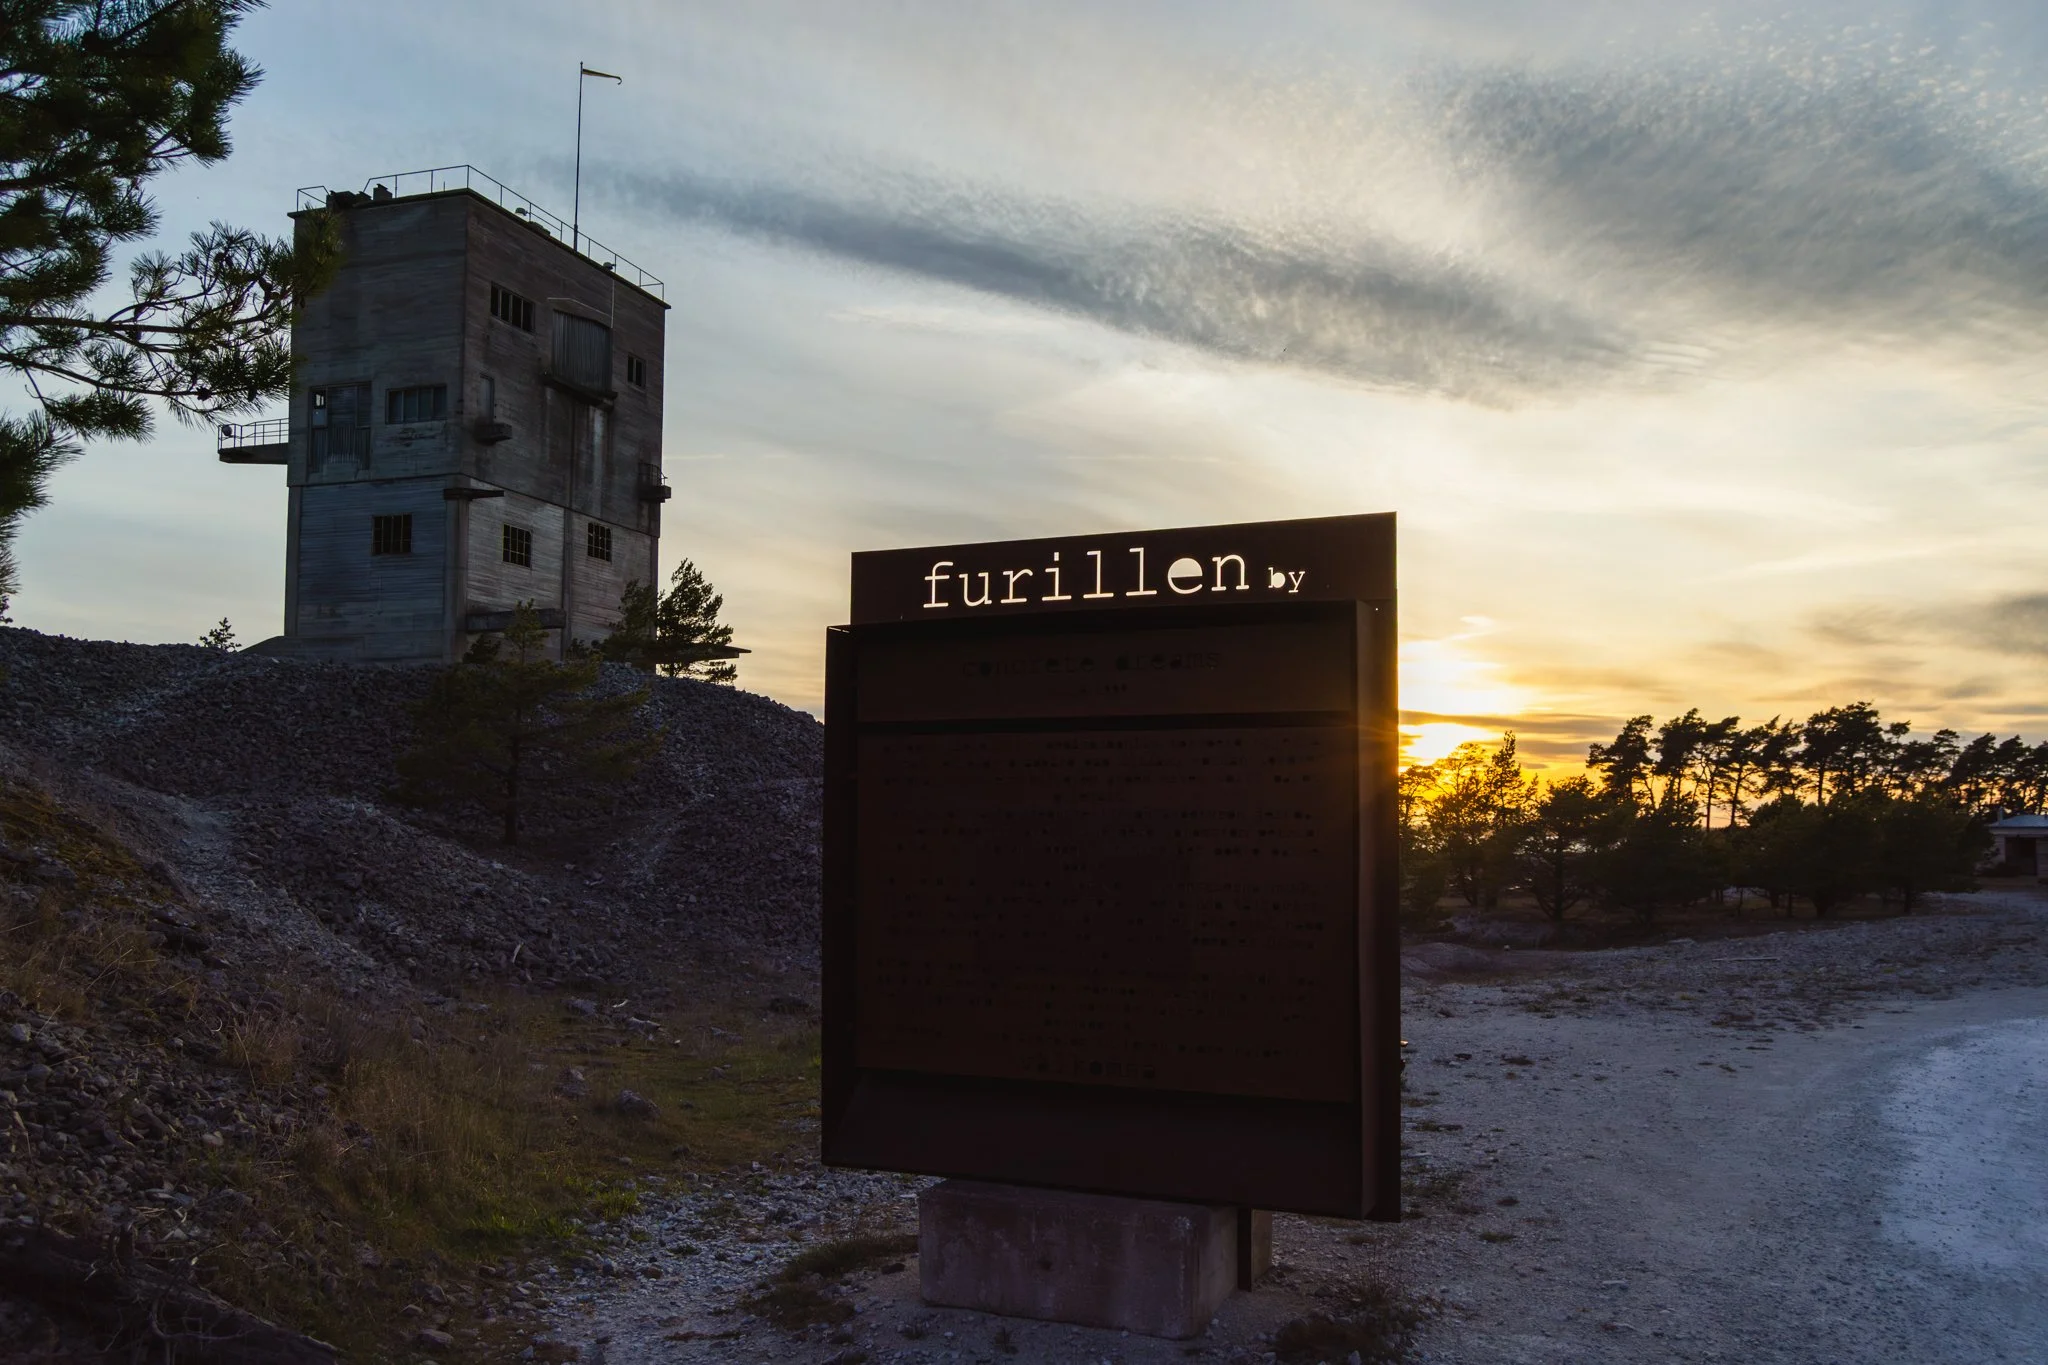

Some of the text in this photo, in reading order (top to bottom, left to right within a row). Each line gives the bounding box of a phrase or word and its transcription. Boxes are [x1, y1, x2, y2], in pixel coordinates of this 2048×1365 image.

[923, 547, 1306, 609] furillen by
[960, 649, 1222, 677] concrete dreams
